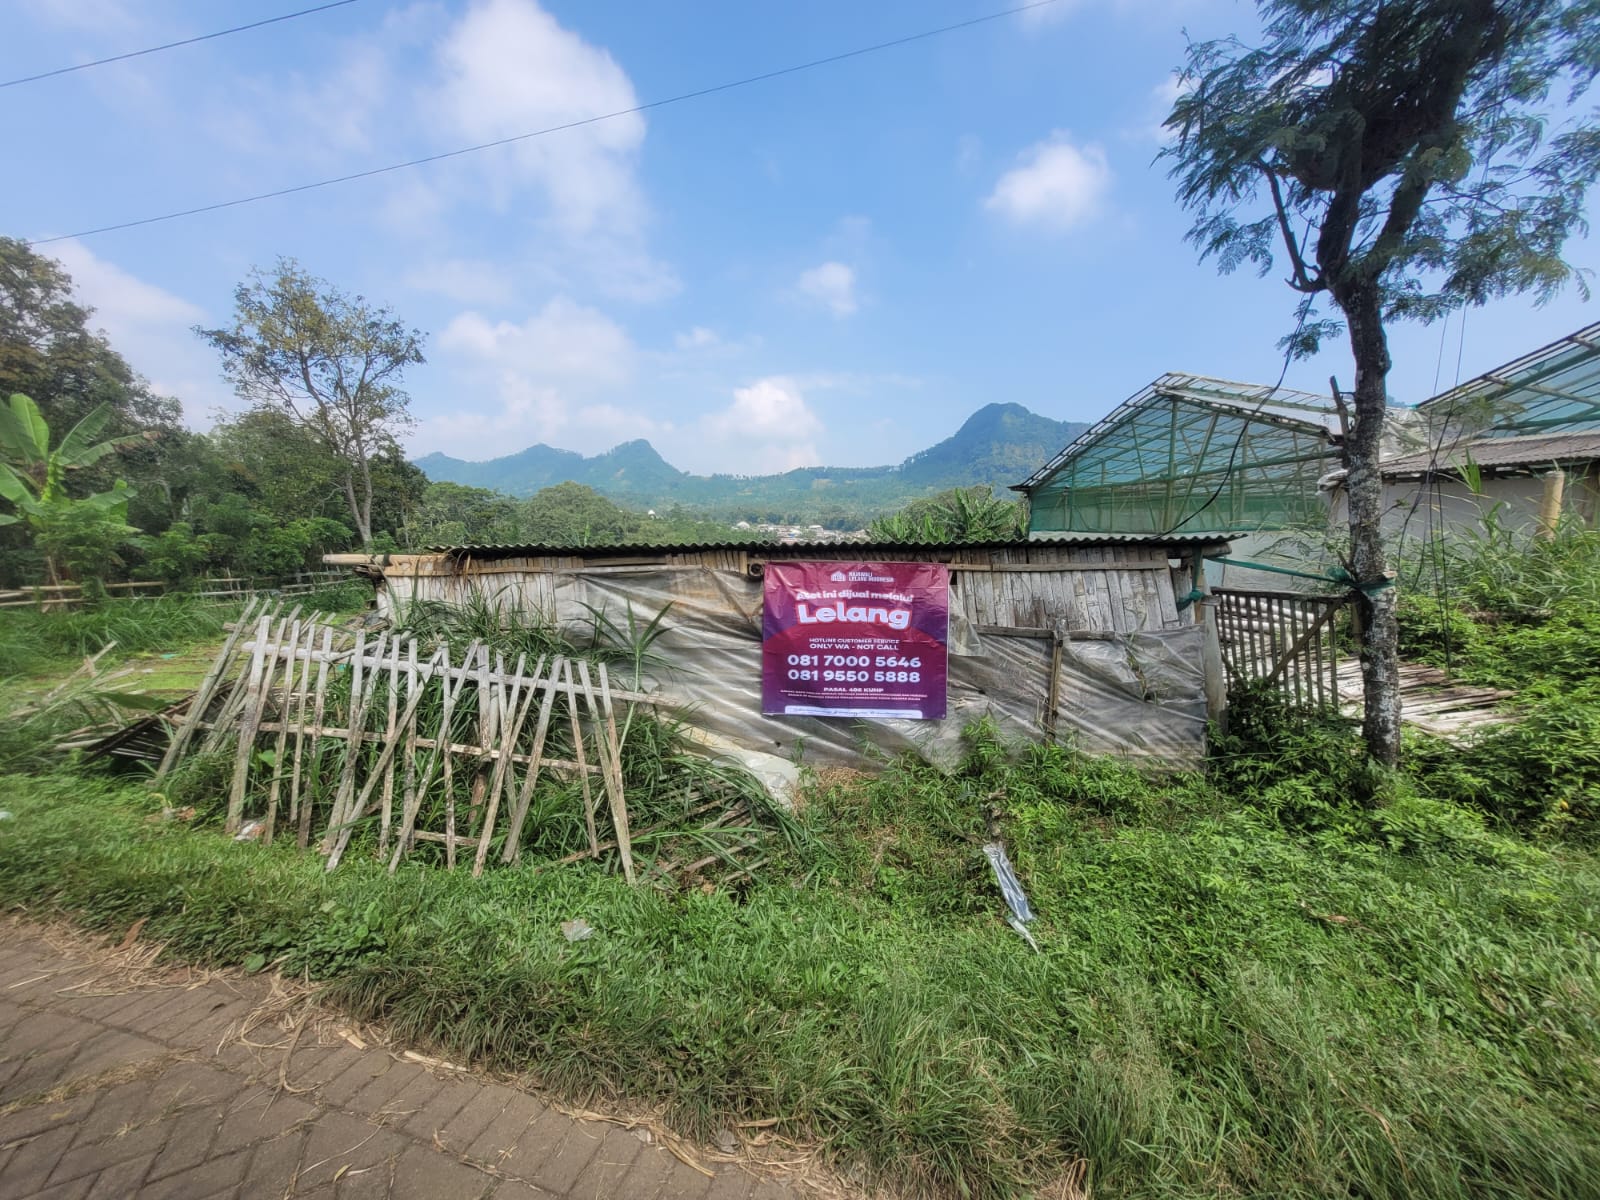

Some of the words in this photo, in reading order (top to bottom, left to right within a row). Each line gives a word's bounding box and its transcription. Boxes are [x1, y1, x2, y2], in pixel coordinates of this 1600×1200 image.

[823, 589, 837, 599] ini
[839, 589, 869, 599] dijual
[871, 591, 914, 602] melalui
[797, 602, 911, 630] Lelang
[787, 655, 818, 666] 081
[823, 655, 870, 667] 7000
[875, 656, 922, 668] 5646
[787, 669, 818, 681] 081
[823, 670, 869, 682] 9550
[874, 671, 921, 683] 5888
